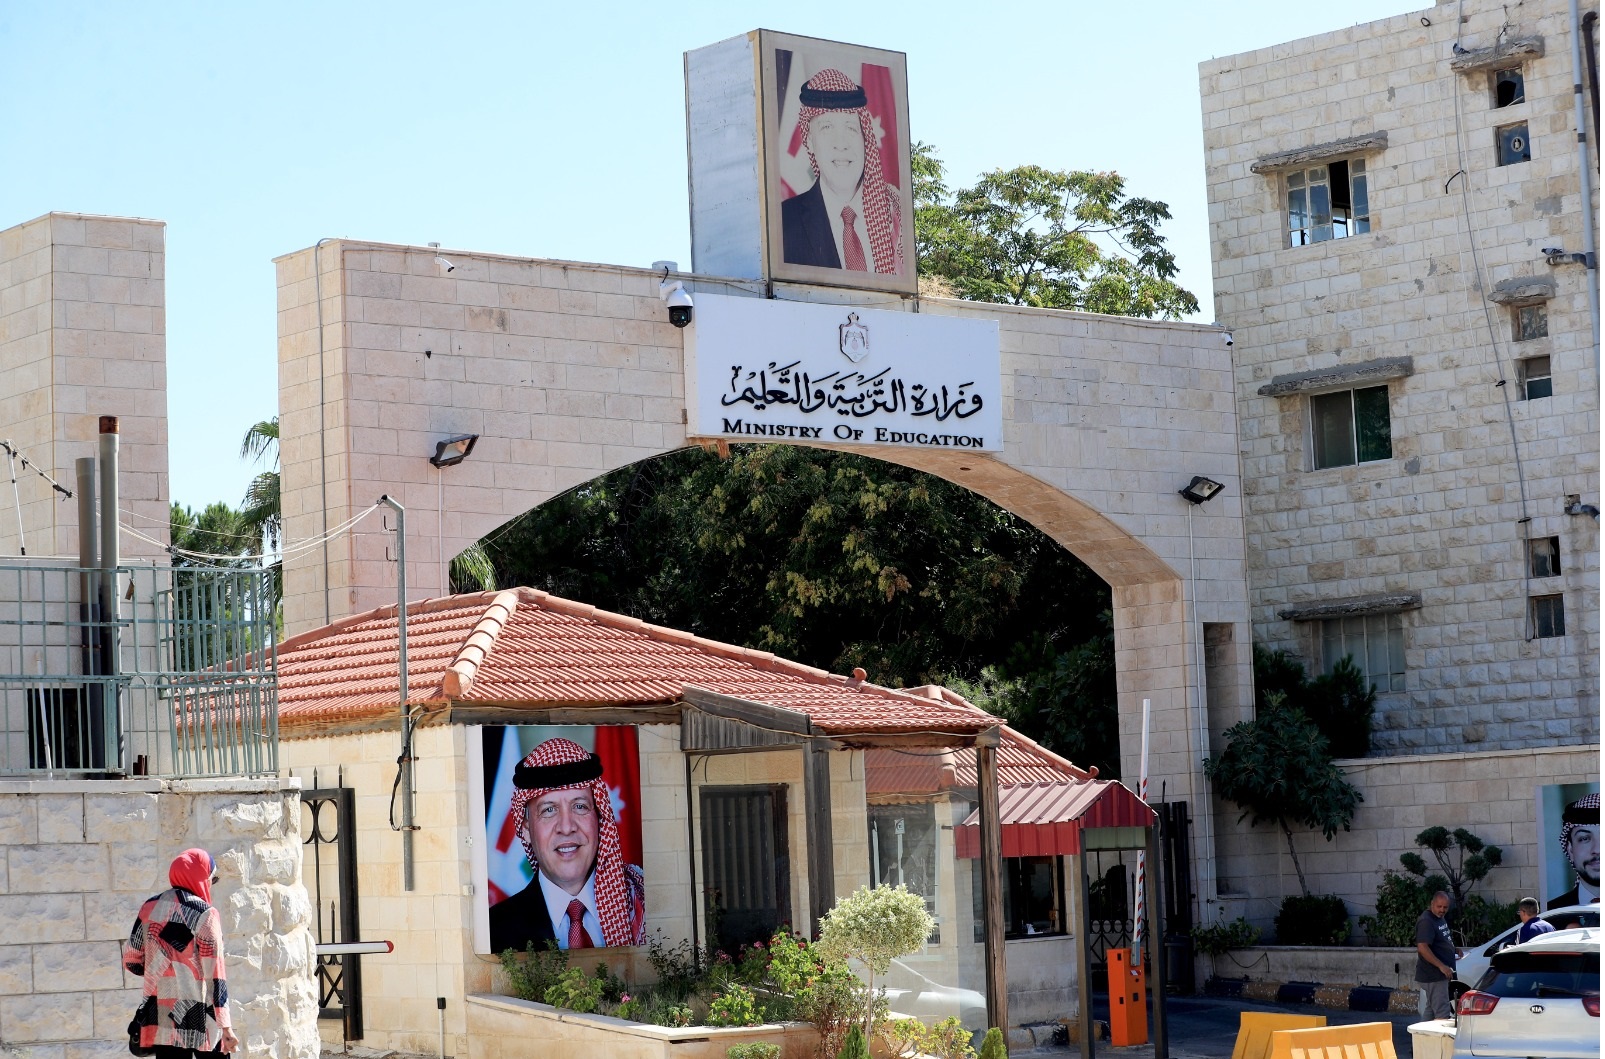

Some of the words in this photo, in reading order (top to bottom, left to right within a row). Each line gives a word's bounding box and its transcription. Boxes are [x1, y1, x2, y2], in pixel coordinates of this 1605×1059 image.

[721, 418, 823, 438] MINISTRY
[833, 424, 864, 441] OF
[874, 427, 984, 448] EDUCATION
